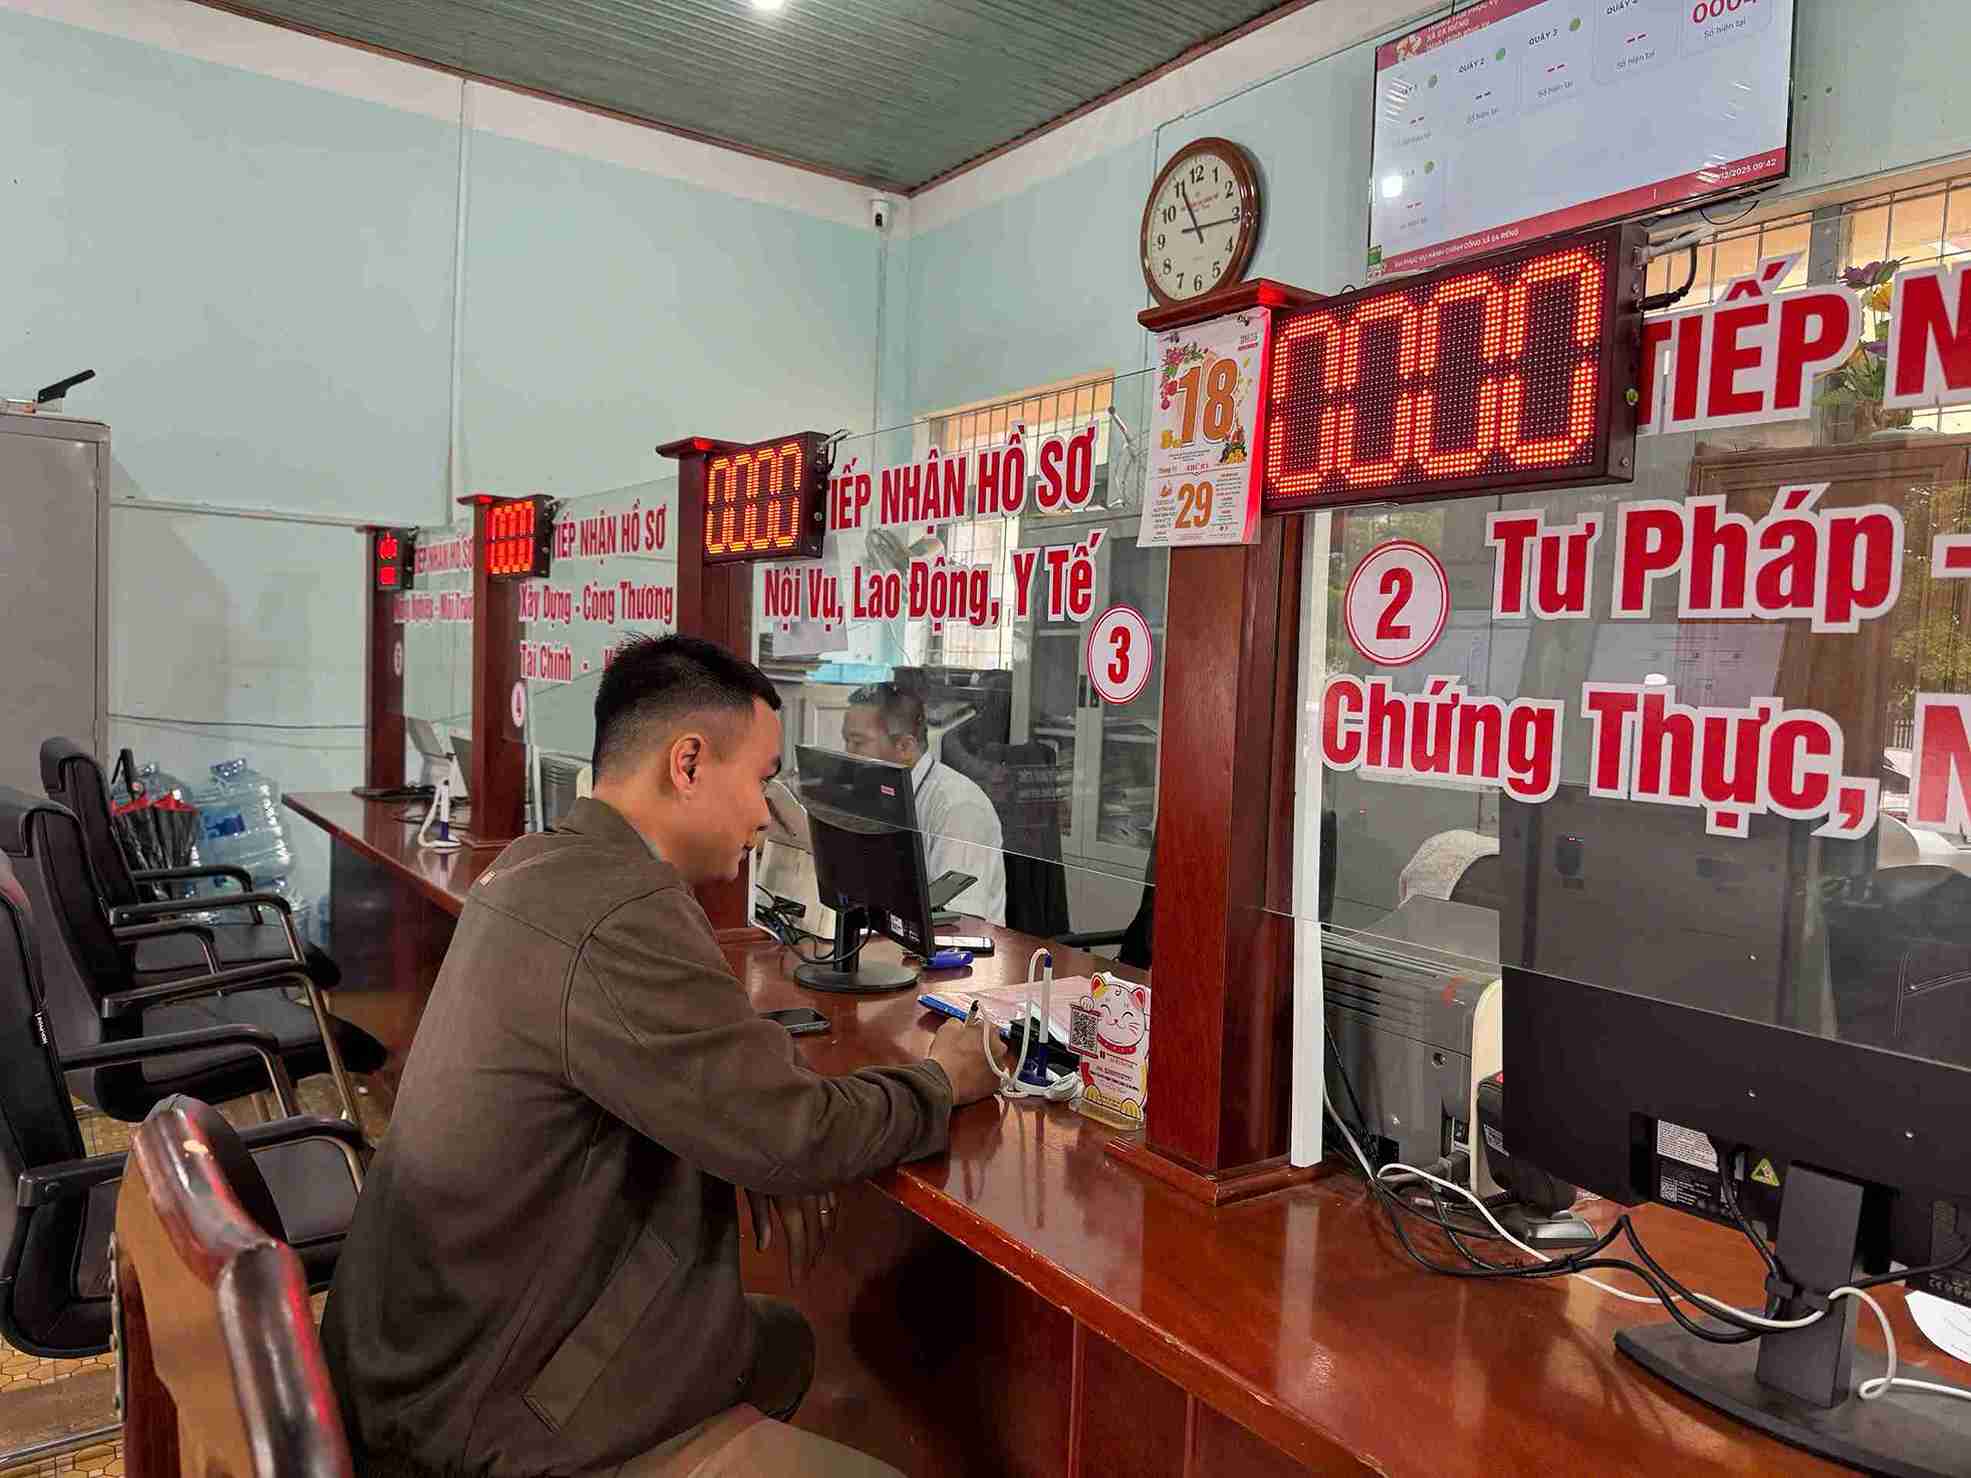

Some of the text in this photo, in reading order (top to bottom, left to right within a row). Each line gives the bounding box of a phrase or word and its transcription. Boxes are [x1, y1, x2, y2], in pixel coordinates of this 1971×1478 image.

[1190, 165, 1204, 184] 12
[1212, 166, 1218, 182] 1
[1225, 180, 1233, 199] 2
[1162, 205, 1176, 224] 10
[1232, 206, 1240, 224] 3
[1158, 234, 1166, 251] 9
[1163, 257, 1171, 275] 8
[1225, 236, 1233, 252] 4
[1176, 272, 1184, 289] 7
[1194, 274, 1202, 291] 6
[1212, 261, 1220, 278] 5
[1268, 250, 1600, 493] 0000
[1177, 359, 1238, 443] 18
[706, 443, 801, 553] 0000
[828, 425, 1095, 534] IẾP NHẬN HỒ SƠ
[1174, 481, 1213, 529] 29
[580, 510, 616, 564] NHẬN
[621, 498, 640, 552] HỒ
[645, 503, 667, 551] SƠ
[1494, 519, 1595, 613] Tư
[1621, 490, 1894, 623] Pháp
[543, 585, 572, 628] Dựng
[583, 581, 615, 625] Công
[620, 581, 673, 625] Thương
[765, 532, 1100, 632] Nội Vụ, Lao Động, Y Tế
[1376, 567, 1414, 639] 2
[1108, 625, 1131, 684] 3
[1322, 680, 1556, 795] Chứng
[1588, 691, 1866, 829] Thực,
